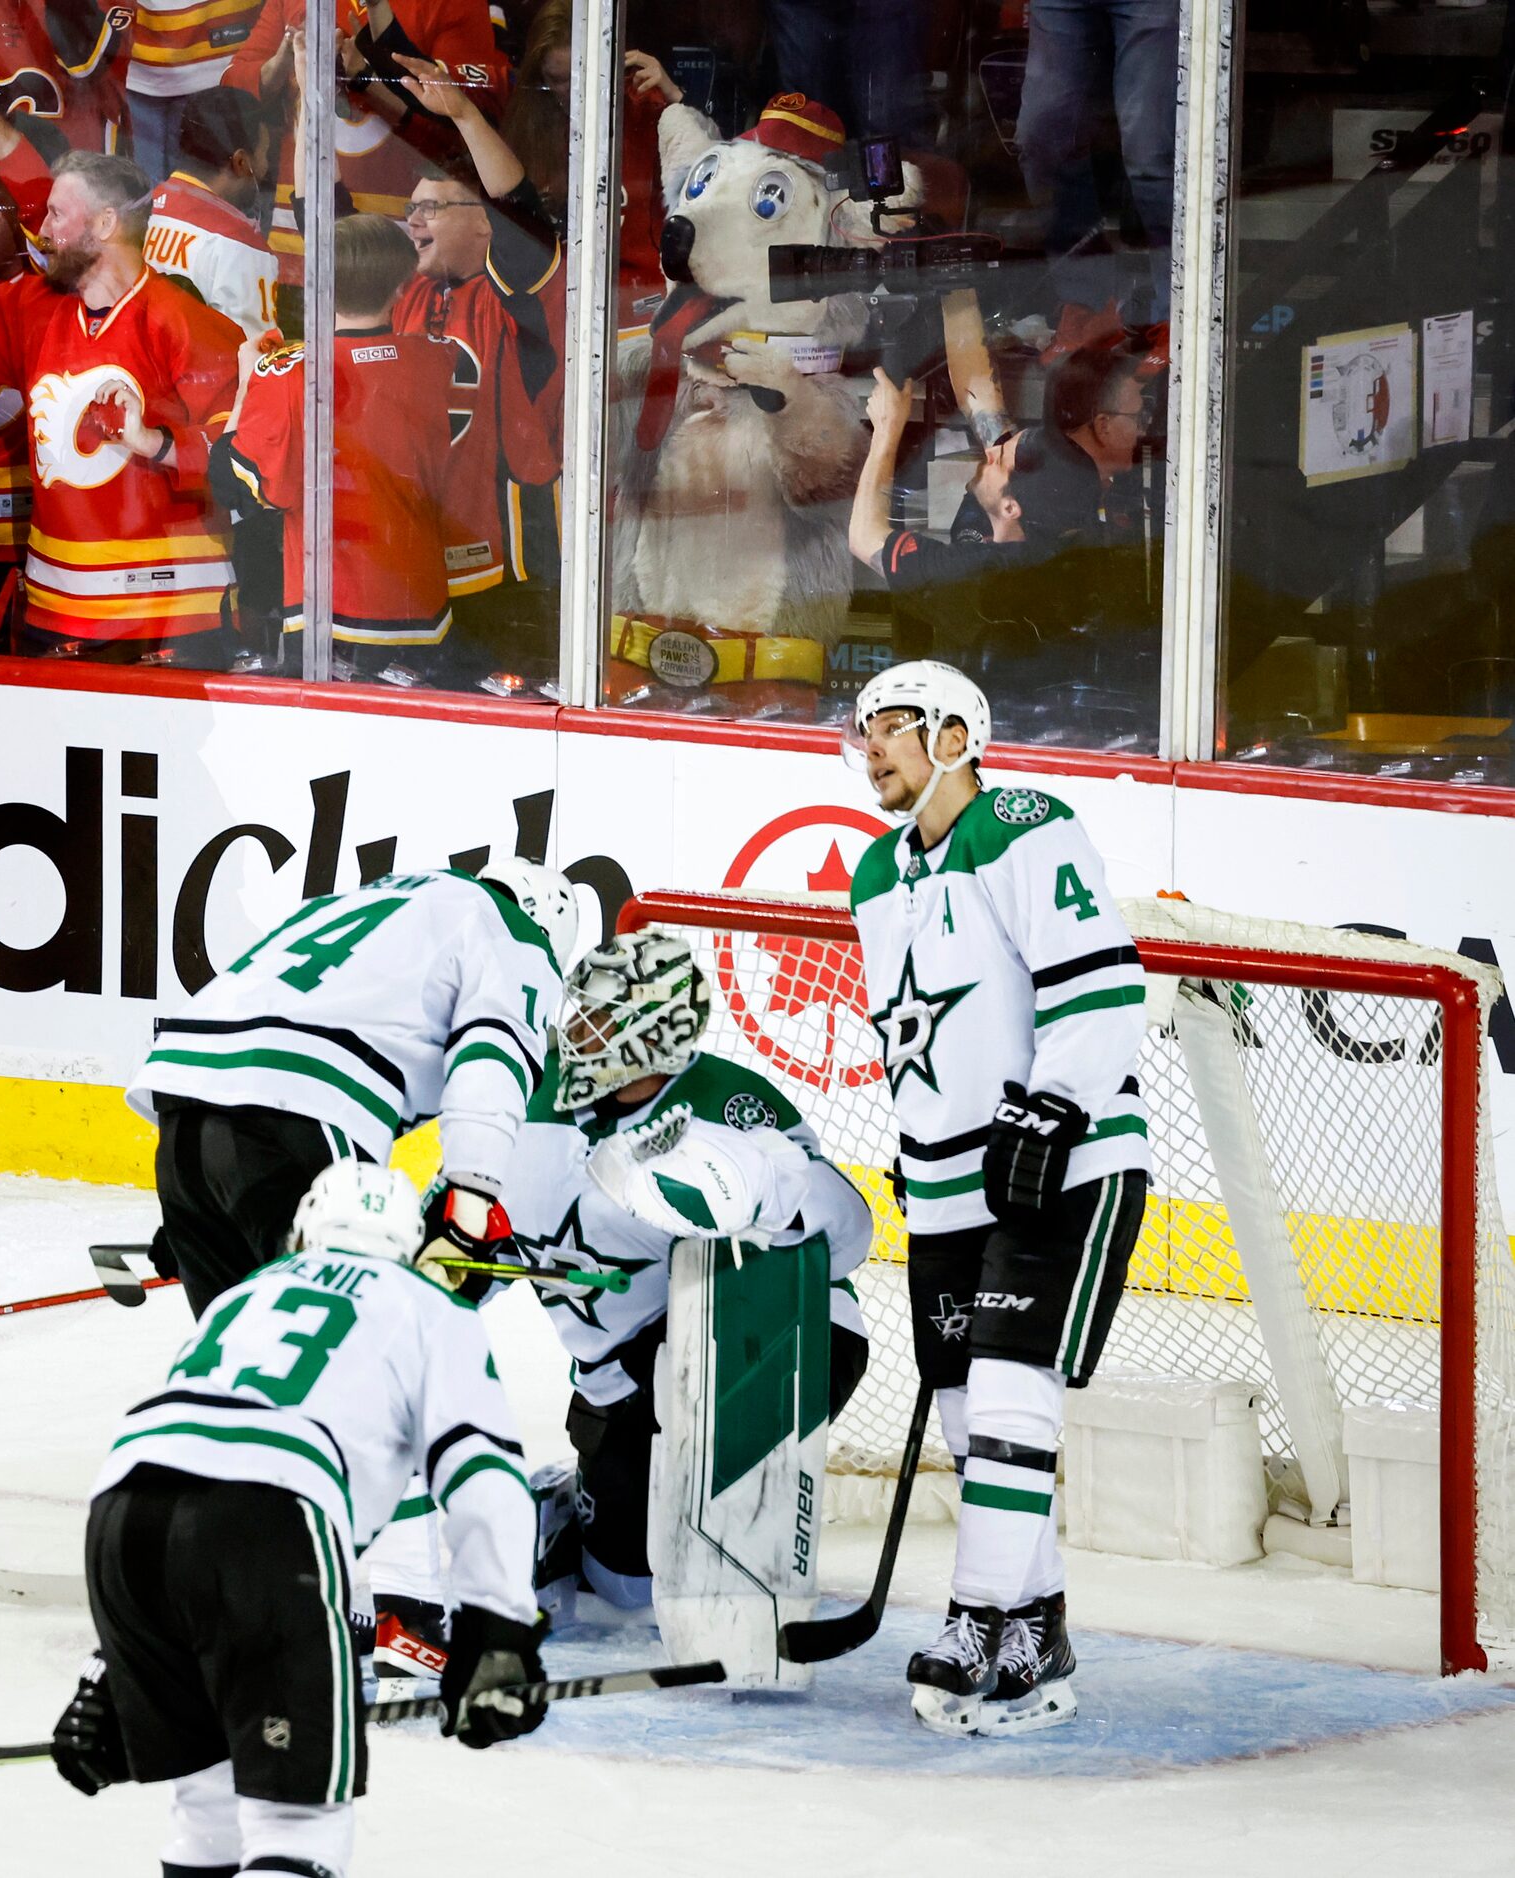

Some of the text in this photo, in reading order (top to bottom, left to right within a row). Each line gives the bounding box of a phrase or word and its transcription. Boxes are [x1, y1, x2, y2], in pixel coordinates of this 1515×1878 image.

[355, 346, 399, 361] CCM
[659, 638, 701, 651] HEALTHY
[659, 650, 690, 664] PAWS
[658, 661, 702, 676] FORWARD
[1054, 862, 1100, 921] 4
[942, 885, 955, 936] A
[704, 1160, 733, 1201] MACH
[360, 1192, 386, 1214] 43
[791, 1469, 814, 1577] BAUER
